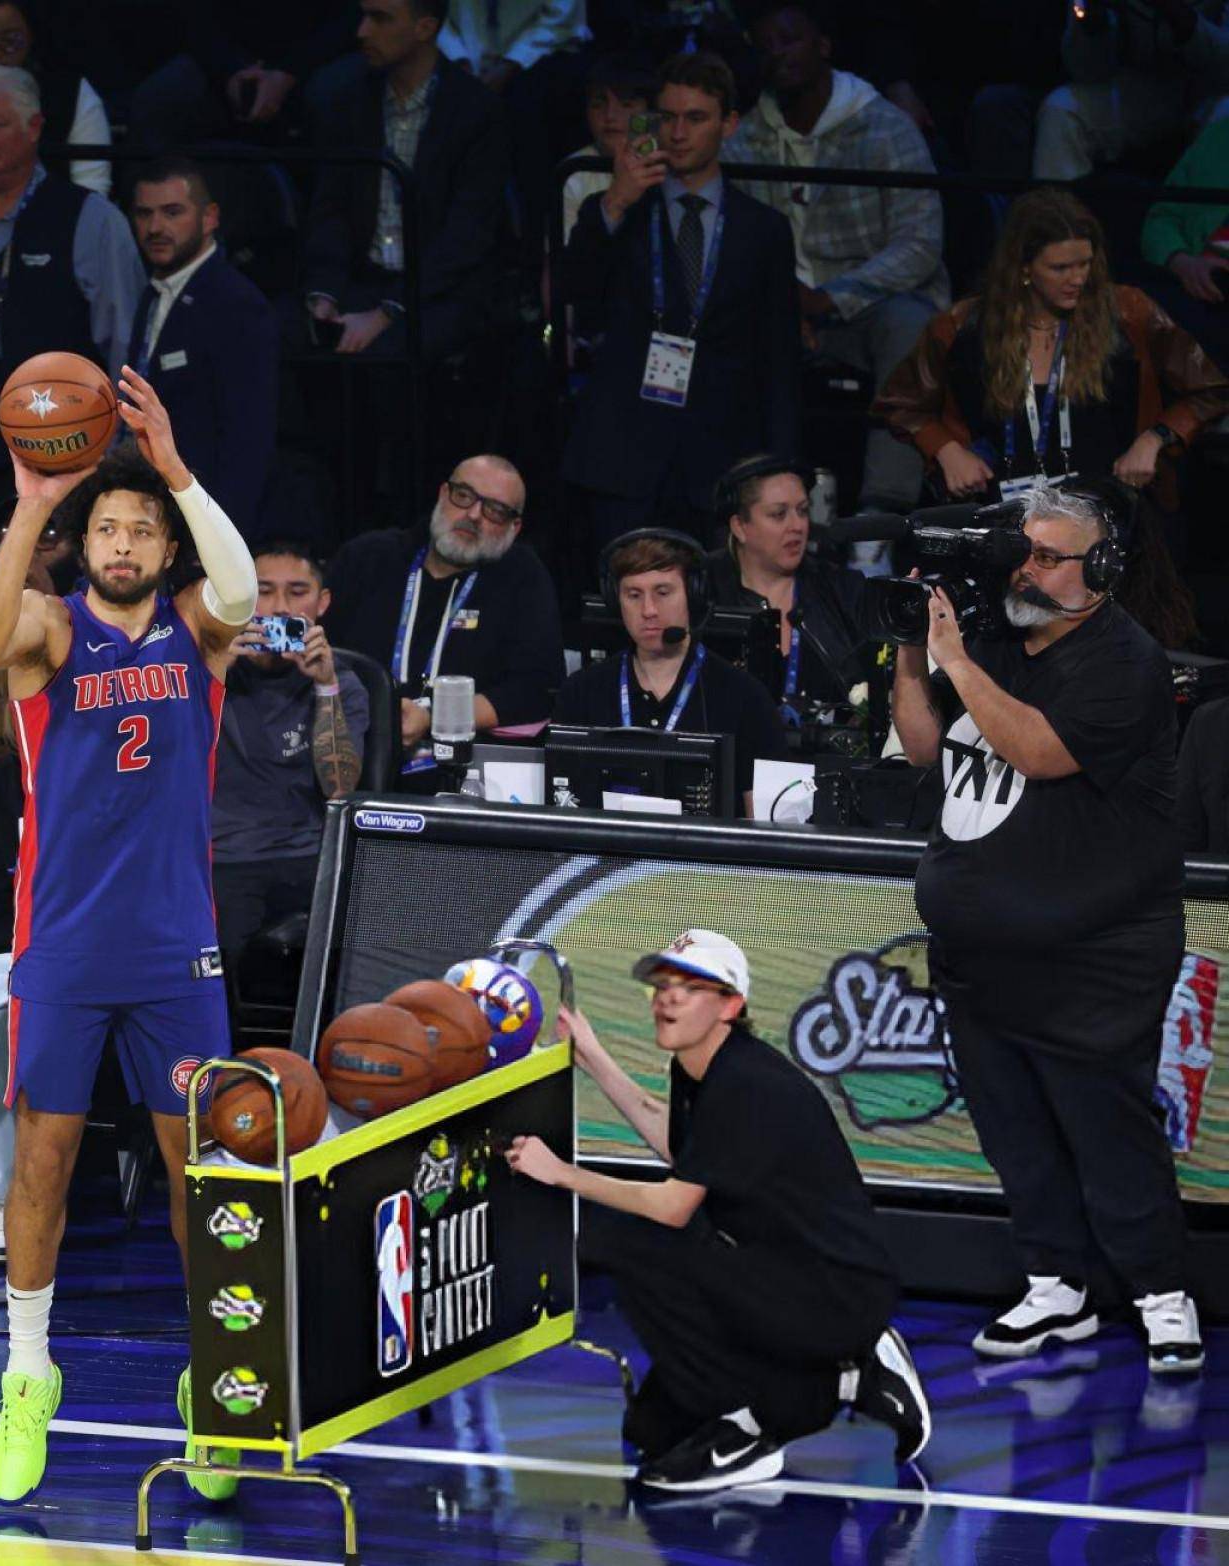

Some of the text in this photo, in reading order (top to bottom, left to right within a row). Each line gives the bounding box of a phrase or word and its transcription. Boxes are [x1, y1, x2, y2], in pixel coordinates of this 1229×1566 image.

[74, 663, 189, 711] DETROIT
[117, 714, 151, 772] 2
[361, 814, 421, 829] Van Wagner
